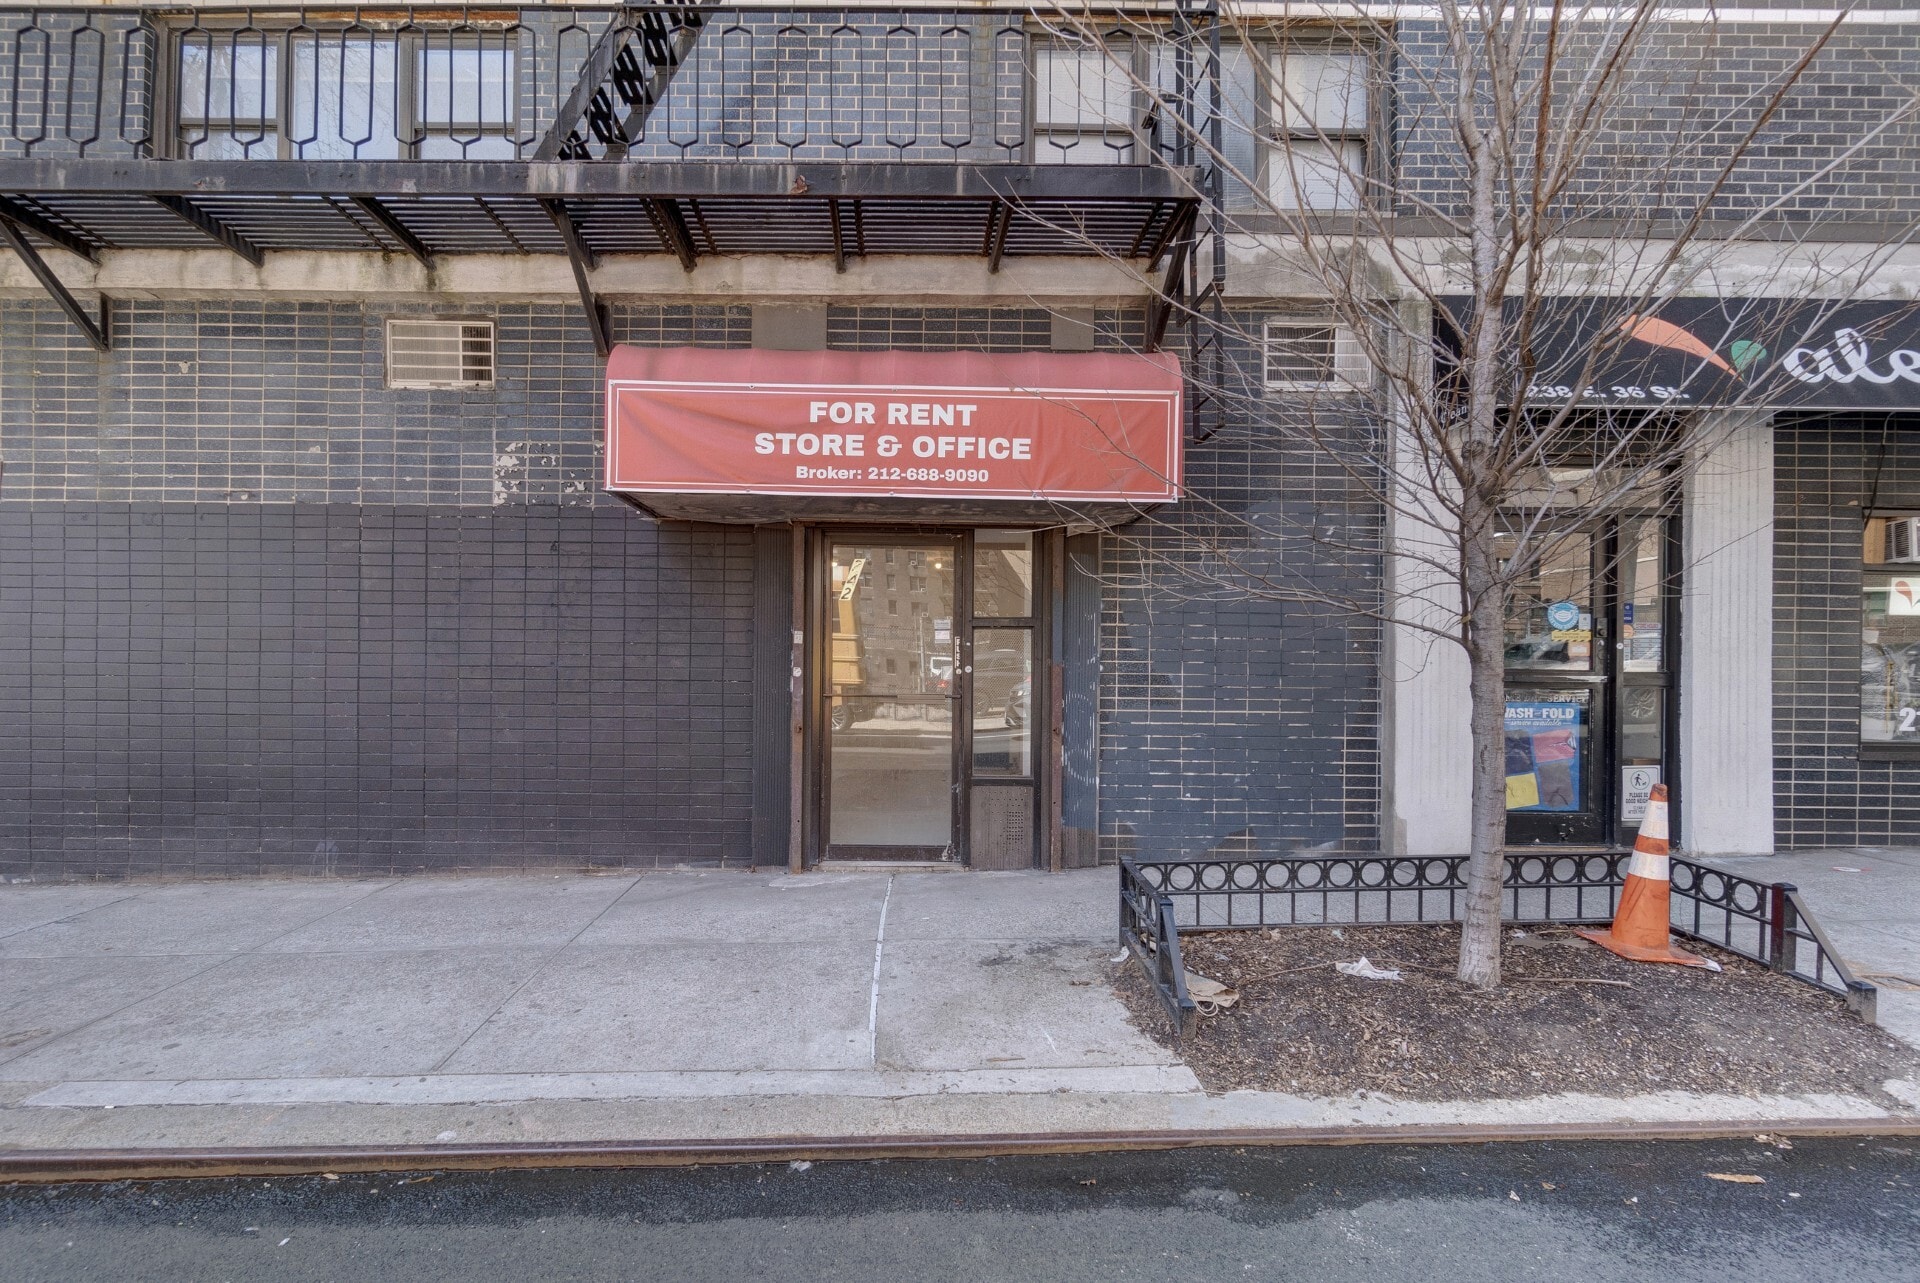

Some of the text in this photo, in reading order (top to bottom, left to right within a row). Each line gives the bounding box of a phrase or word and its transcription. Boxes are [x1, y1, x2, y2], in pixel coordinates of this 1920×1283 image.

[1524, 386, 1572, 398] 238
[1611, 385, 1646, 399] 36
[1650, 385, 1690, 399] St.
[809, 401, 978, 426] FOR RENT
[754, 433, 1032, 459] STORE & OFFICE
[796, 466, 989, 482] Broker: 212-688-9090
[1542, 708, 1575, 719] FOLD
[1899, 707, 1920, 732] 2
